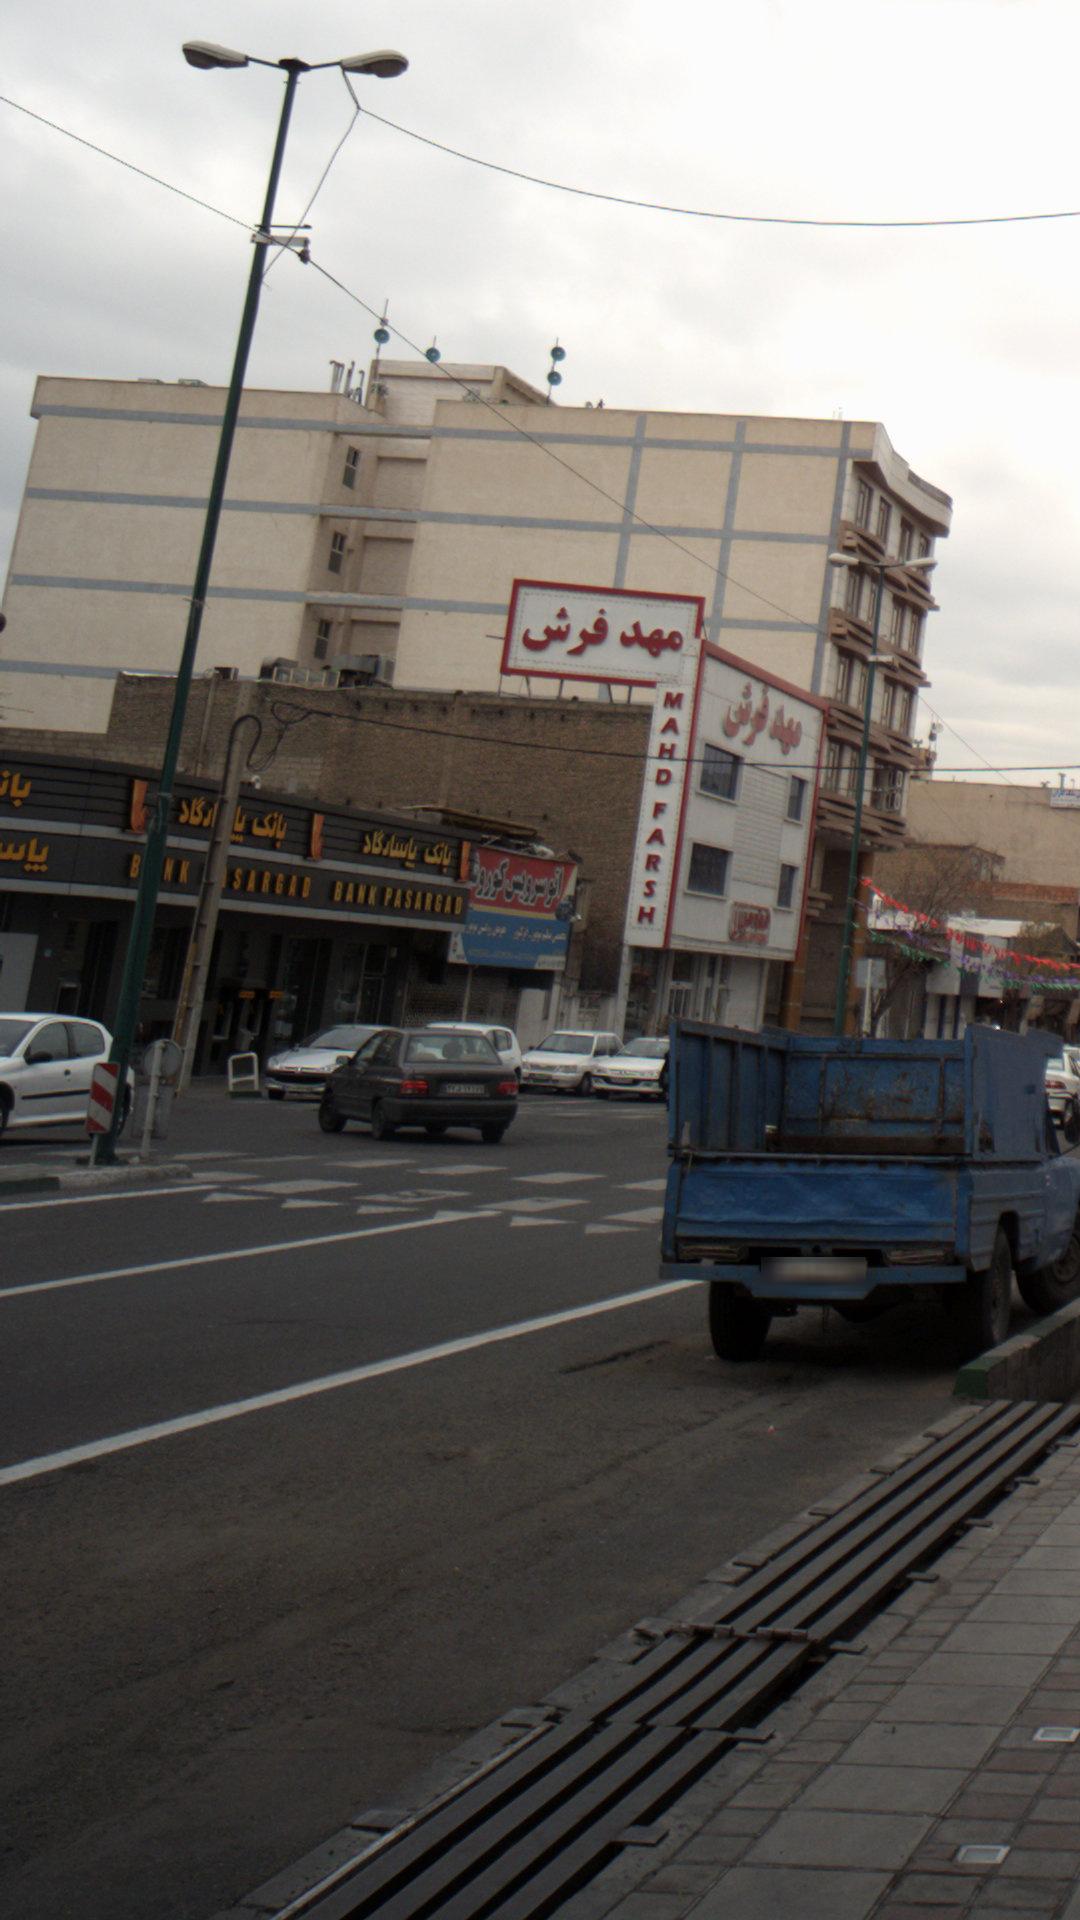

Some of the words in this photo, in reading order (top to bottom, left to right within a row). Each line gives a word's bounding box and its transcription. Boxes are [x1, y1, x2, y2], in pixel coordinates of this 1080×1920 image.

[522, 606, 609, 656] فرش
[620, 619, 684, 658] مهد
[723, 681, 769, 746] فرش
[770, 704, 803, 756] مهد
[654, 691, 684, 787] MAHD
[0, 769, 32, 808] بان
[178, 795, 247, 842] پاارگاد
[251, 810, 288, 849] بانک
[363, 831, 417, 868] پاسارگاد
[424, 842, 453, 873] بانک
[637, 801, 668, 926] FARSH
[129, 853, 191, 885] BNK
[221, 863, 312, 899] SARGAD
[333, 880, 378, 906] BANK
[384, 886, 464, 916] PASARGAD
